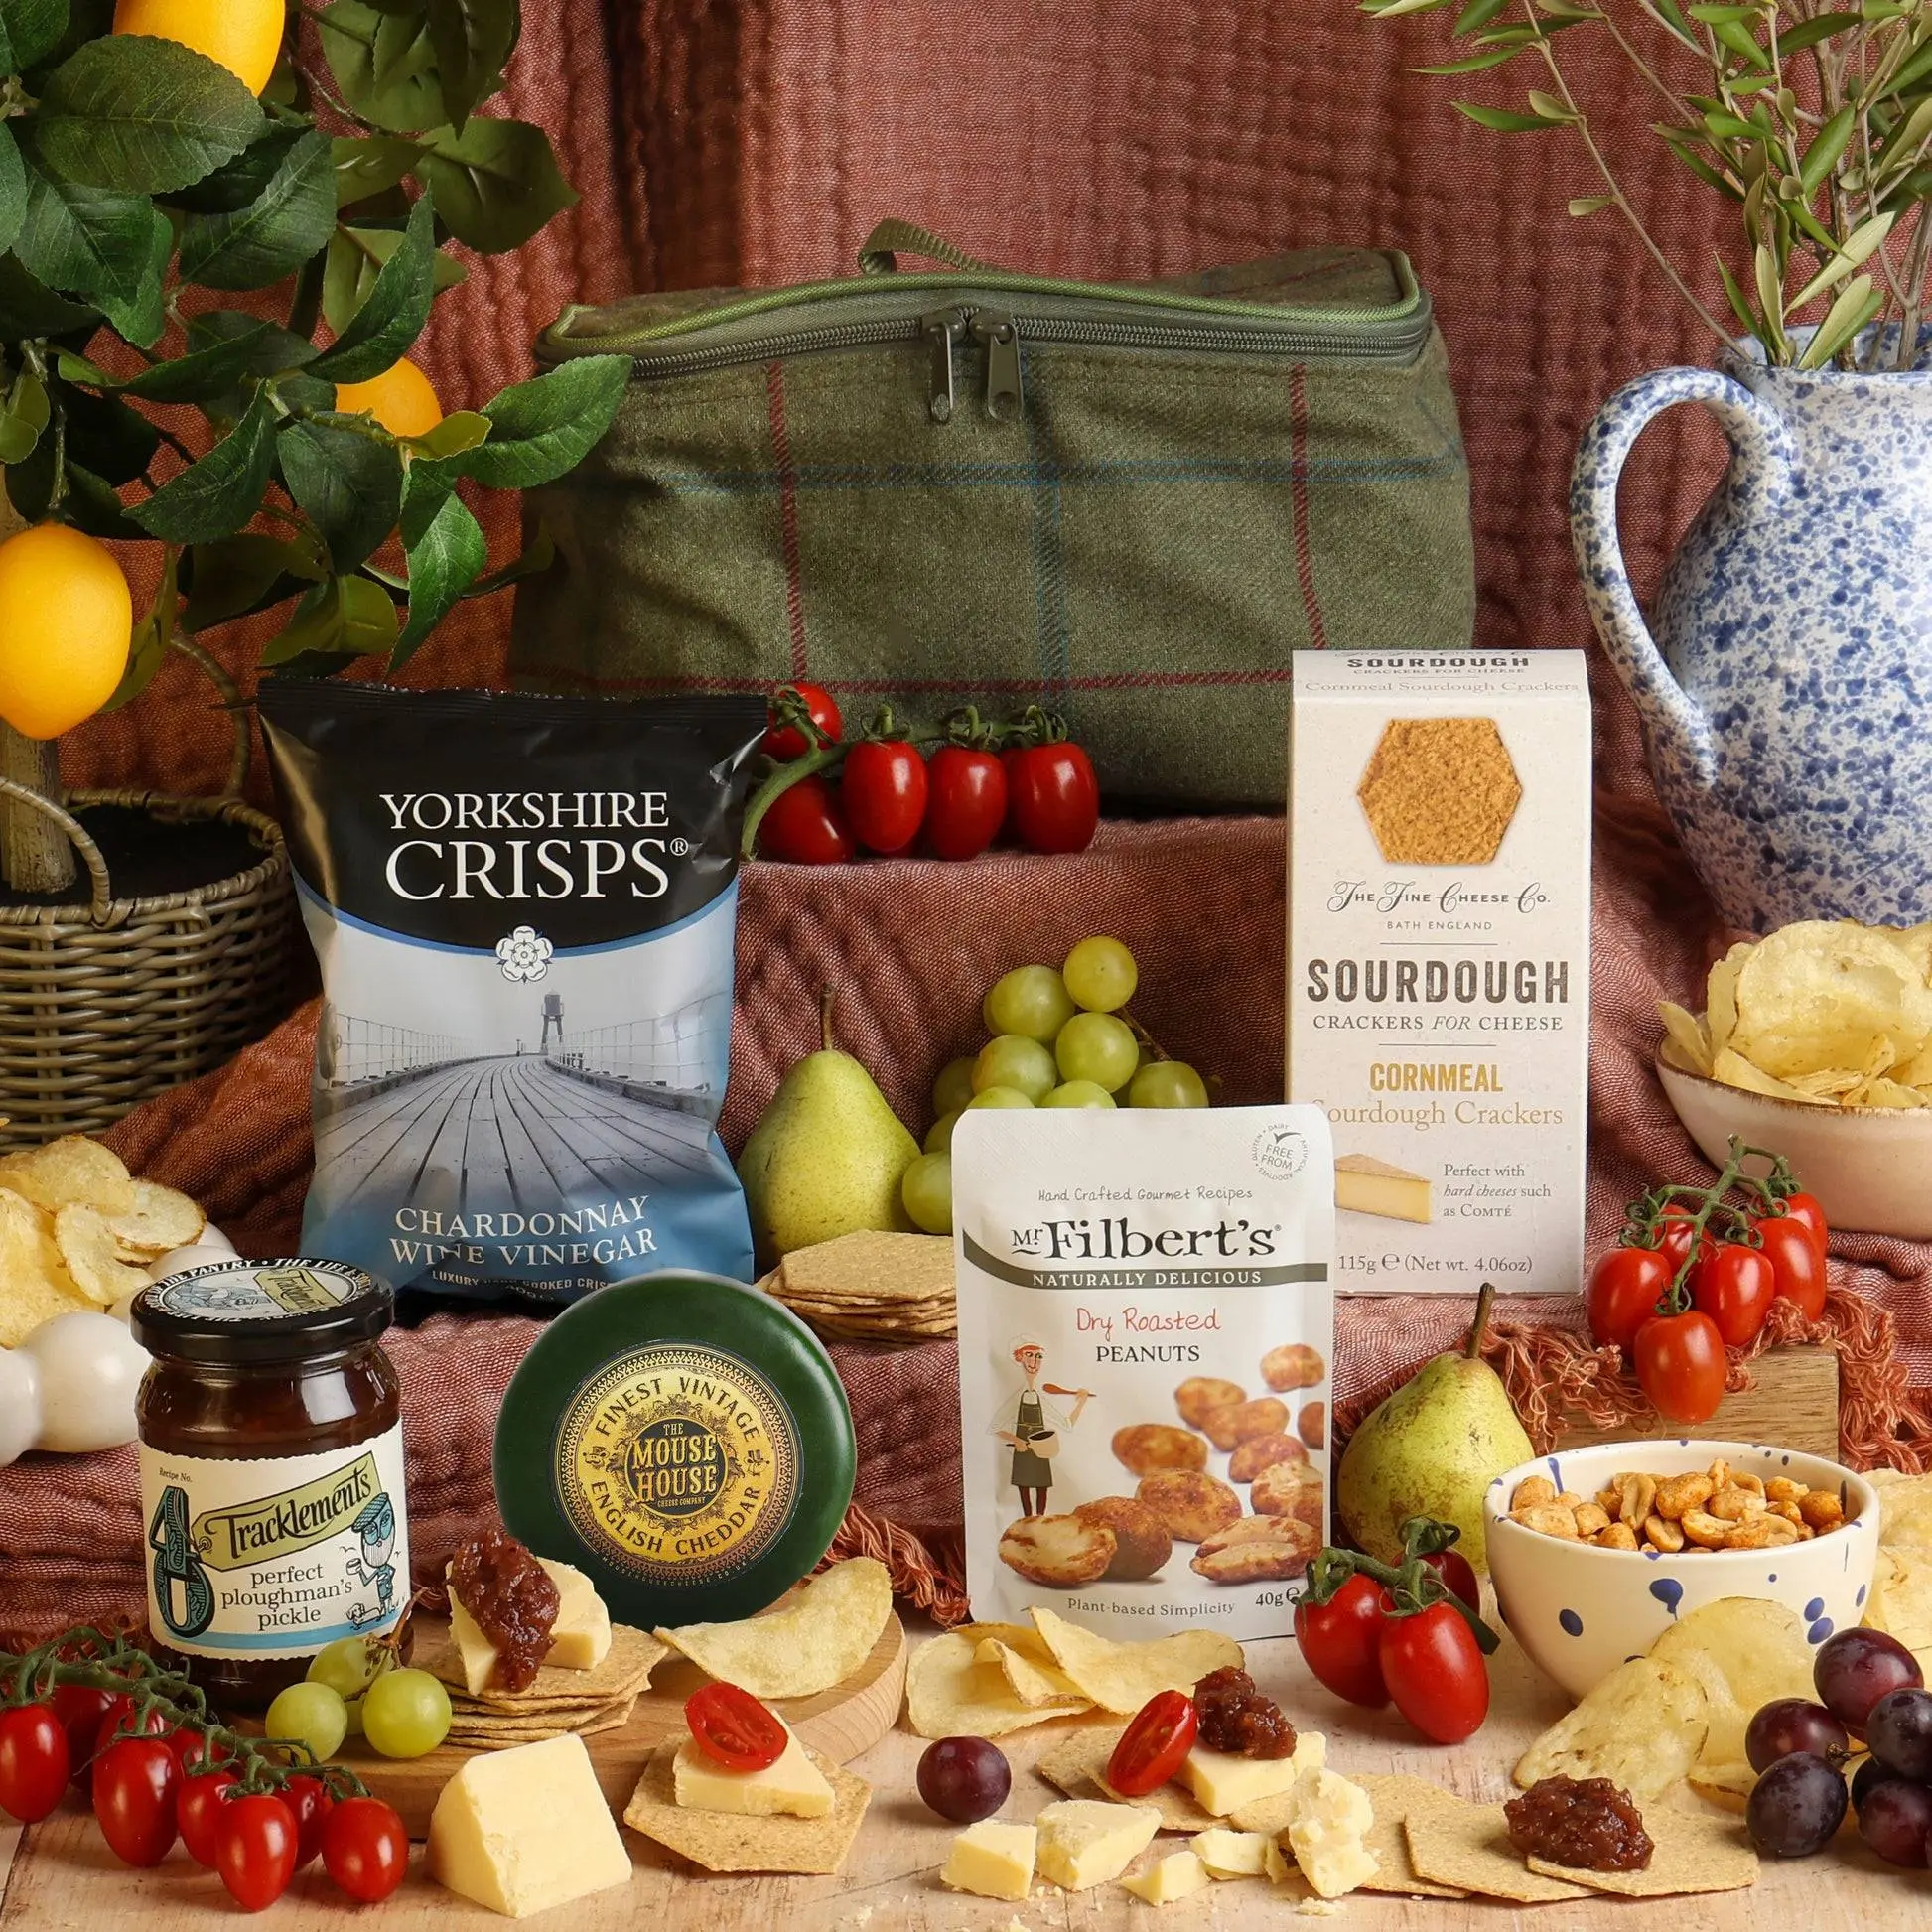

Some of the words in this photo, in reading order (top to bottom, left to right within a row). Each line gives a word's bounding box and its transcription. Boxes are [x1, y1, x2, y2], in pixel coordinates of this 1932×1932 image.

[1346, 657, 1530, 668] SOURDOUGH
[1305, 682, 1392, 692] Cornmeal
[1398, 681, 1495, 694] Sourdough
[1501, 681, 1580, 691] Crackers
[379, 791, 670, 830] YORKSHIRE
[1387, 921, 1421, 930] BATH
[1428, 921, 1493, 930] ENGLAND
[1307, 959, 1570, 1004] SOURDOUGH
[1312, 1015, 1424, 1030] CRACKERS
[1432, 1016, 1471, 1031] FOR
[1479, 1017, 1564, 1031] CHEESE
[1369, 1063, 1503, 1093] CORNMEAL
[1312, 1099, 1446, 1132] ourdough
[1454, 1100, 1564, 1125] Crackers
[1265, 1143, 1294, 1160] FREE
[1261, 1153, 1293, 1171] FROM
[1444, 1163, 1491, 1177] Perfect
[1495, 1164, 1526, 1177] with
[1038, 1189, 1070, 1202] Hand
[1074, 1188, 1133, 1201] Crafted
[1137, 1188, 1191, 1201] Gourmet
[1197, 1186, 1254, 1205] Recipes
[1443, 1183, 1475, 1197] hard
[1476, 1183, 1518, 1197] cheeses
[1521, 1183, 1552, 1197] such
[395, 1194, 649, 1239] CHARDONNAY
[1443, 1207, 1456, 1217] as
[388, 1237, 485, 1267] WINE
[497, 1228, 659, 1267] VINEGAR
[188, 1259, 255, 1277] PANTRY
[274, 1258, 312, 1268] THE
[314, 1260, 349, 1272] LIFE
[1338, 1255, 1376, 1273] 115g
[1405, 1255, 1440, 1272] (Net
[1447, 1257, 1468, 1272] wt.
[1474, 1255, 1534, 1274] 4.06oz)
[432, 1269, 480, 1287] LUXURY
[1033, 1271, 1148, 1287] NATURALLY
[1155, 1270, 1263, 1285] DELICIOUS
[1076, 1307, 1114, 1341] Dry
[1123, 1307, 1222, 1332] Roasted
[1096, 1345, 1201, 1363] PEANUTS
[596, 1378, 663, 1439] FINEST
[679, 1375, 761, 1443] VINTAGE
[662, 1422, 685, 1436] THE
[631, 1433, 717, 1470] MOUSE
[158, 1466, 180, 1480] Recipe
[180, 1471, 193, 1483] No.
[635, 1463, 718, 1503] HOUSE
[204, 1459, 373, 1560] Tracklements
[591, 1480, 664, 1554] ENGLISH
[675, 1487, 761, 1556] CHEDDAR
[250, 1563, 325, 1587] perfect
[220, 1578, 353, 1610] ploughman's
[1255, 1591, 1285, 1607] 40g
[1067, 1597, 1156, 1616] Plant-based
[1160, 1600, 1236, 1619] Simplicity
[257, 1607, 322, 1631] pickle
